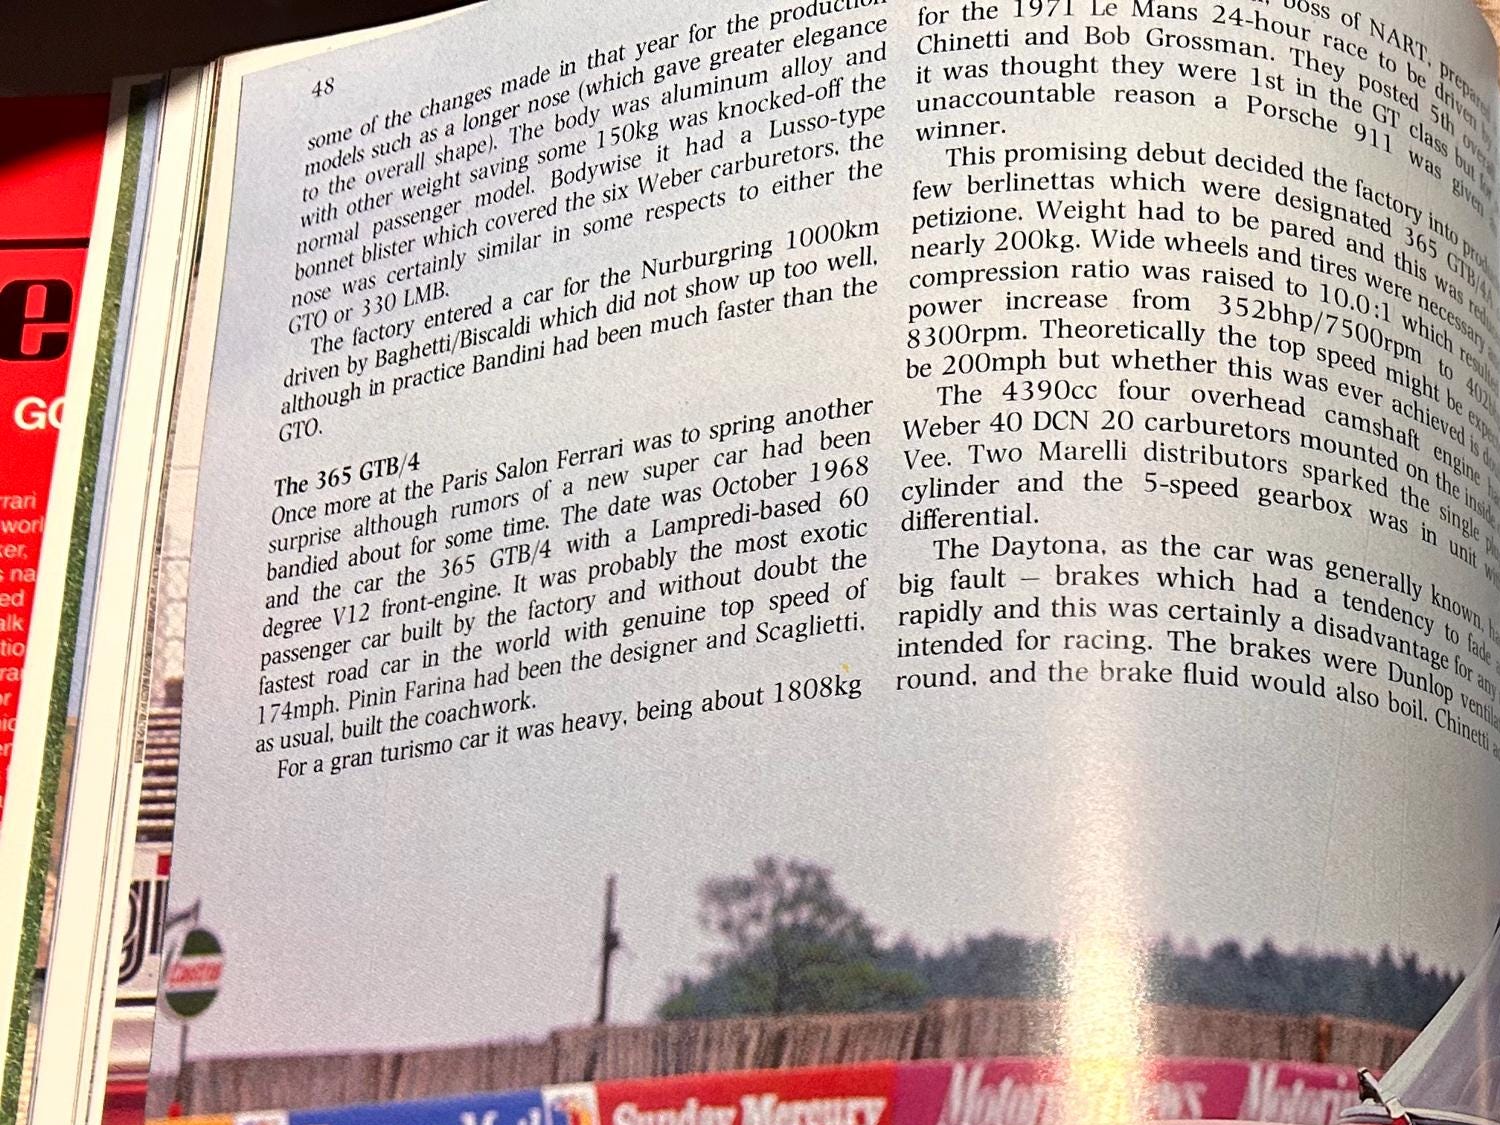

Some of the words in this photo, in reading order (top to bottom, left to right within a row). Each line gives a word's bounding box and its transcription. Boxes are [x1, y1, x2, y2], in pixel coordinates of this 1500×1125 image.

[305, 145, 365, 177] models
[371, 132, 411, 159] such
[419, 128, 438, 145] as
[444, 123, 455, 137] a
[463, 103, 521, 132] longer
[528, 90, 570, 114] nose
[578, 65, 645, 102] (which
[653, 56, 701, 85] gave
[709, 38, 785, 71] greater
[793, 18, 888, 49] elegance
[311, 76, 335, 98] 48
[915, 120, 1006, 142] winner.
[945, 145, 996, 168] This
[1004, 141, 1128, 168] promising
[1136, 141, 1206, 166] debut
[1215, 147, 1304, 182] decided
[1313, 167, 1348, 193] the
[1355, 178, 1423, 226] factory
[1429, 211, 1458, 244] into
[288, 309, 328, 335] GTO
[333, 307, 354, 324] or
[362, 292, 397, 318] 330
[403, 280, 449, 308] LMB.
[310, 334, 344, 355] The
[352, 319, 415, 347] factory
[424, 294, 492, 330] entered
[502, 296, 513, 311] a
[523, 287, 554, 306] car
[564, 276, 590, 297] for
[600, 267, 631, 289] the
[641, 239, 773, 280] Nurburgring
[788, 219, 879, 250] 1000km
[271, 505, 317, 526] Once
[324, 494, 371, 516] more
[378, 487, 396, 506] at
[404, 479, 434, 501] the
[442, 468, 488, 494] Paris
[495, 457, 548, 483] Salon
[557, 438, 623, 470] Ferrari
[632, 433, 672, 454] was
[681, 427, 701, 445] to
[709, 414, 775, 443] spring
[785, 397, 874, 427] another
[278, 413, 323, 438] GTO.
[902, 415, 981, 438] Weber
[989, 411, 1023, 433] 40
[1033, 409, 1089, 431] DCN
[1100, 409, 1134, 431] 20
[1144, 411, 1290, 445] carburetors
[1300, 433, 1398, 473] mounted
[1406, 463, 1429, 485] on
[1435, 471, 1460, 500] the
[274, 475, 309, 497] The
[316, 465, 352, 490] 365
[359, 451, 420, 481] GTB/4
[900, 502, 1039, 531] differential.
[897, 629, 1003, 658] intended
[1016, 628, 1051, 651] for
[1064, 629, 1153, 655] racing.
[1170, 629, 1217, 654] The
[1230, 632, 1311, 665] brakes
[1323, 652, 1377, 677] were
[1388, 660, 1454, 705] Dunlop
[277, 758, 308, 779] For
[313, 758, 324, 773] a
[330, 751, 373, 776] gran
[381, 738, 453, 763] turismo
[459, 732, 490, 751] car
[496, 725, 509, 745] it
[516, 721, 554, 741] was
[636, 698, 693, 722] being
[701, 687, 764, 713] about
[775, 674, 862, 703] 1808kg
